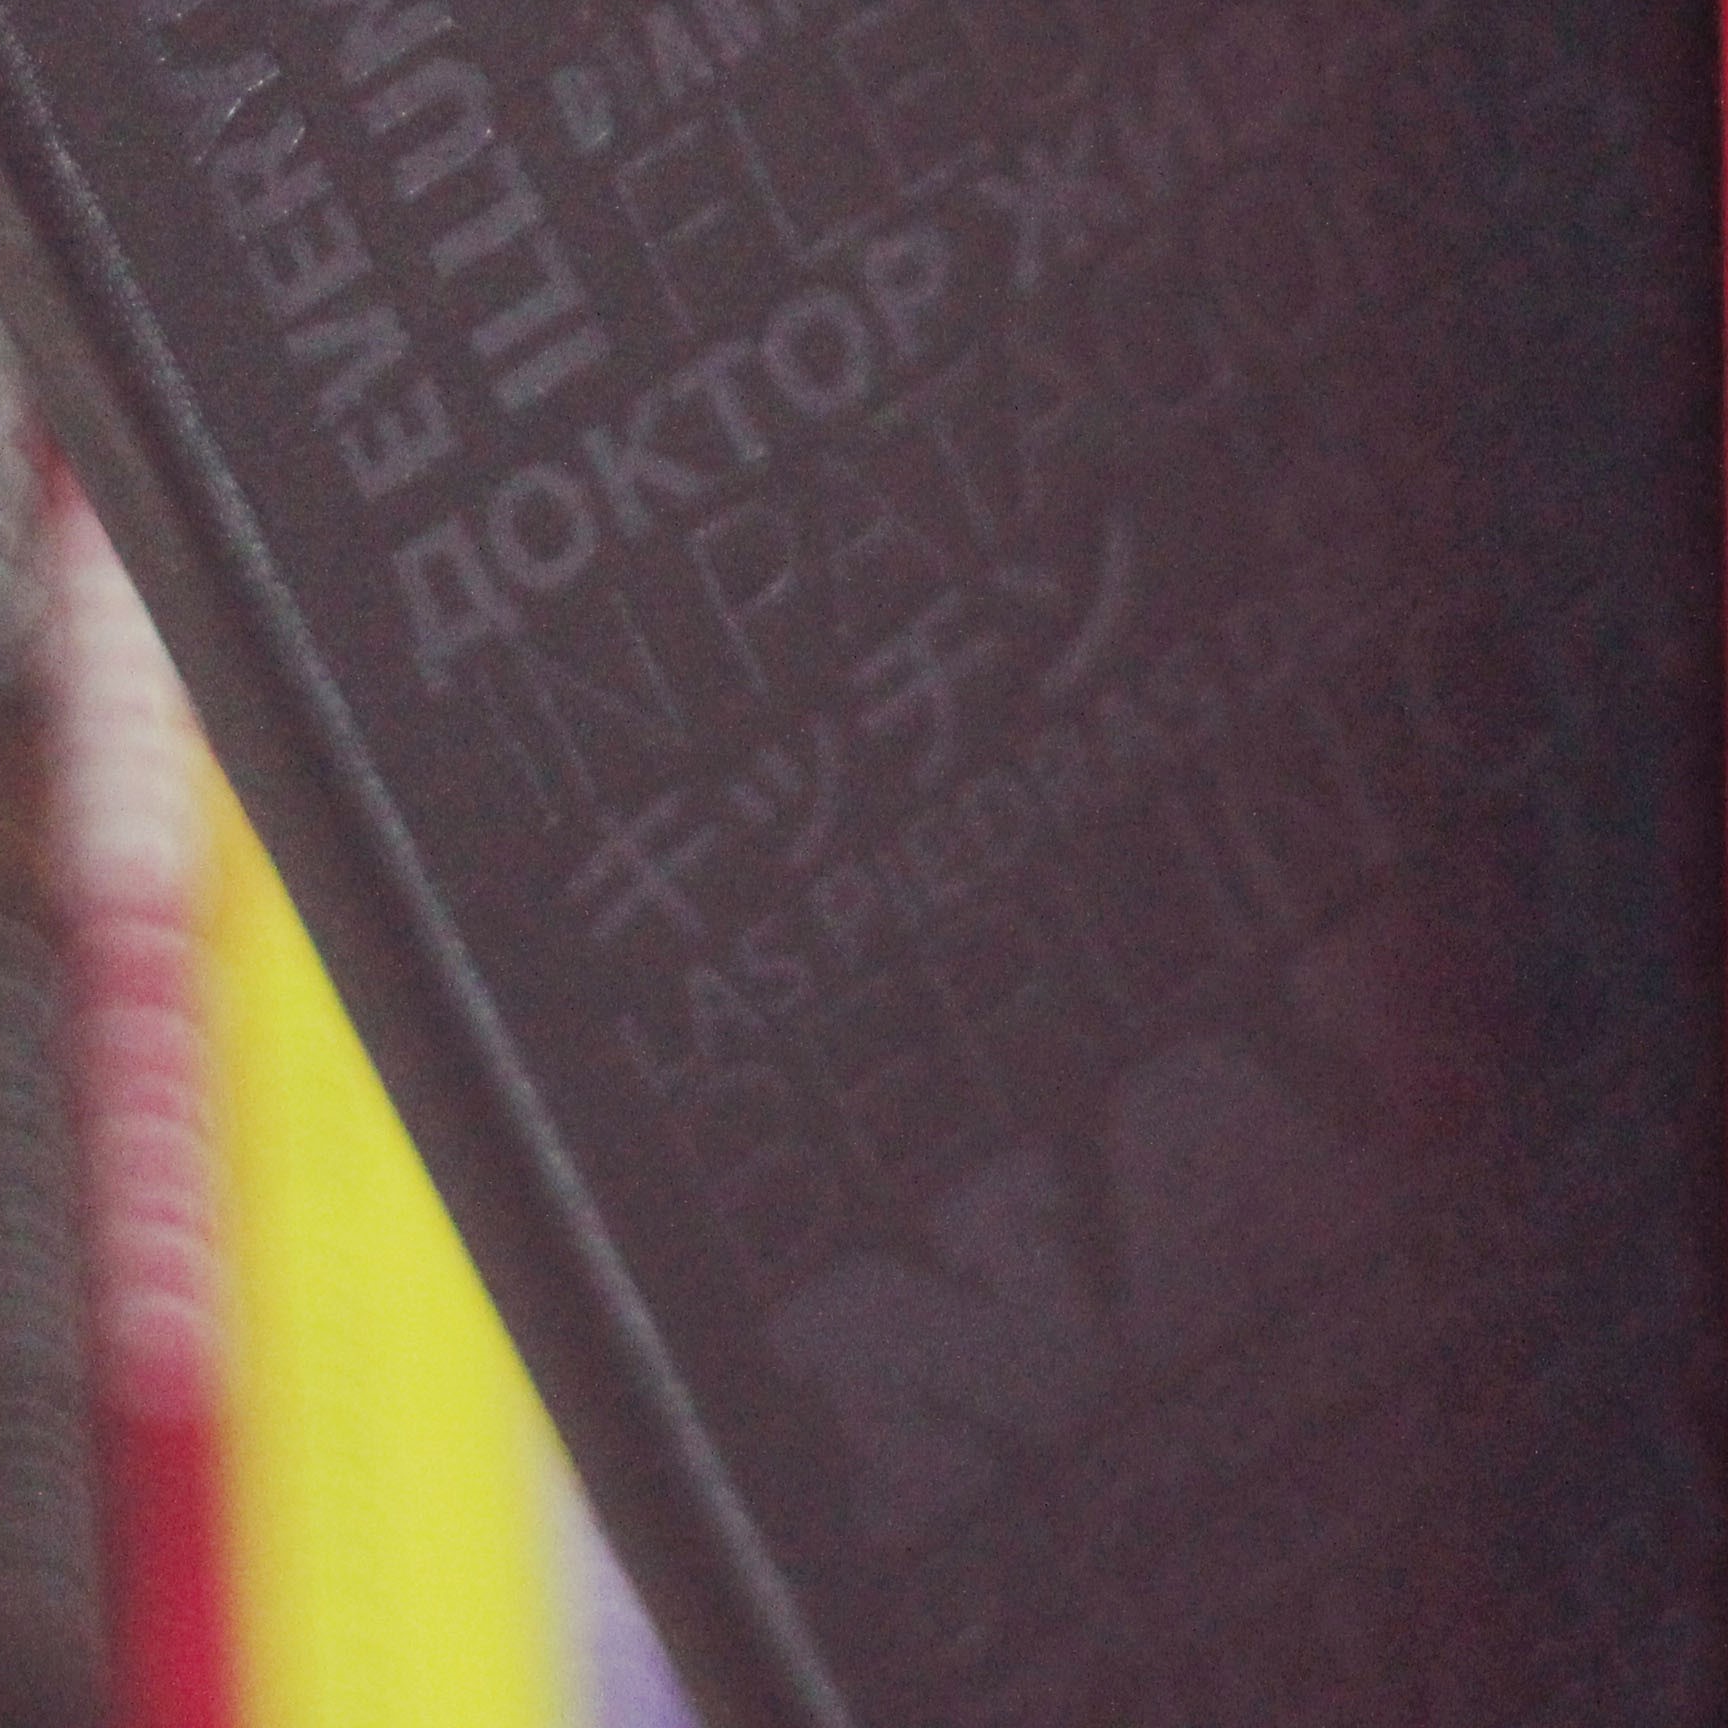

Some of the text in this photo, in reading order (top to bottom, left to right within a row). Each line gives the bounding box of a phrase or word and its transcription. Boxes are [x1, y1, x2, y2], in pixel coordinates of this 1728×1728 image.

[389, 225, 950, 698] ДОКТОР
[566, 505, 1135, 944] キッチン
